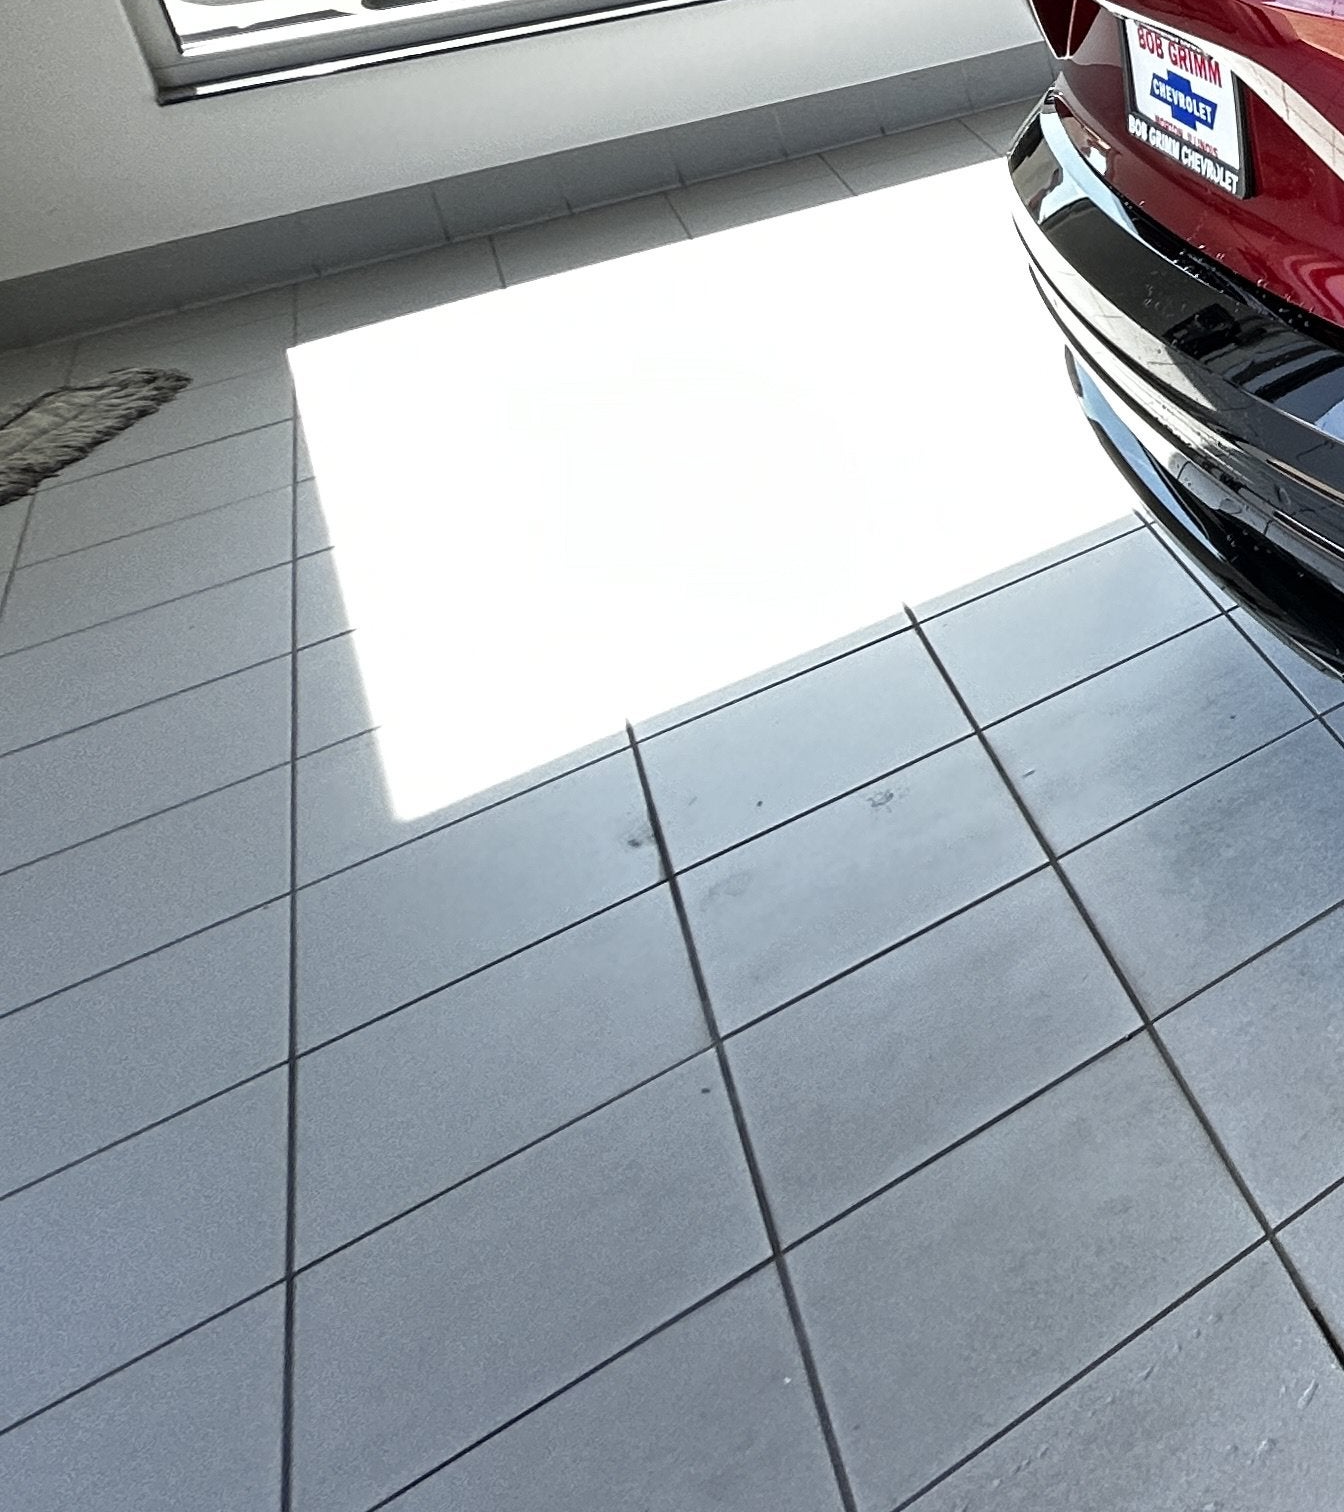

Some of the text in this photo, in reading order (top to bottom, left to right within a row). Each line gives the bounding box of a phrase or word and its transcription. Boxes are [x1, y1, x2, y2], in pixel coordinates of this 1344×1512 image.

[1137, 25, 1222, 89] BOB GRIMM
[1152, 78, 1214, 124] CHEVROLET
[1128, 114, 1239, 195] BOB GRIMM CHEVROLET
